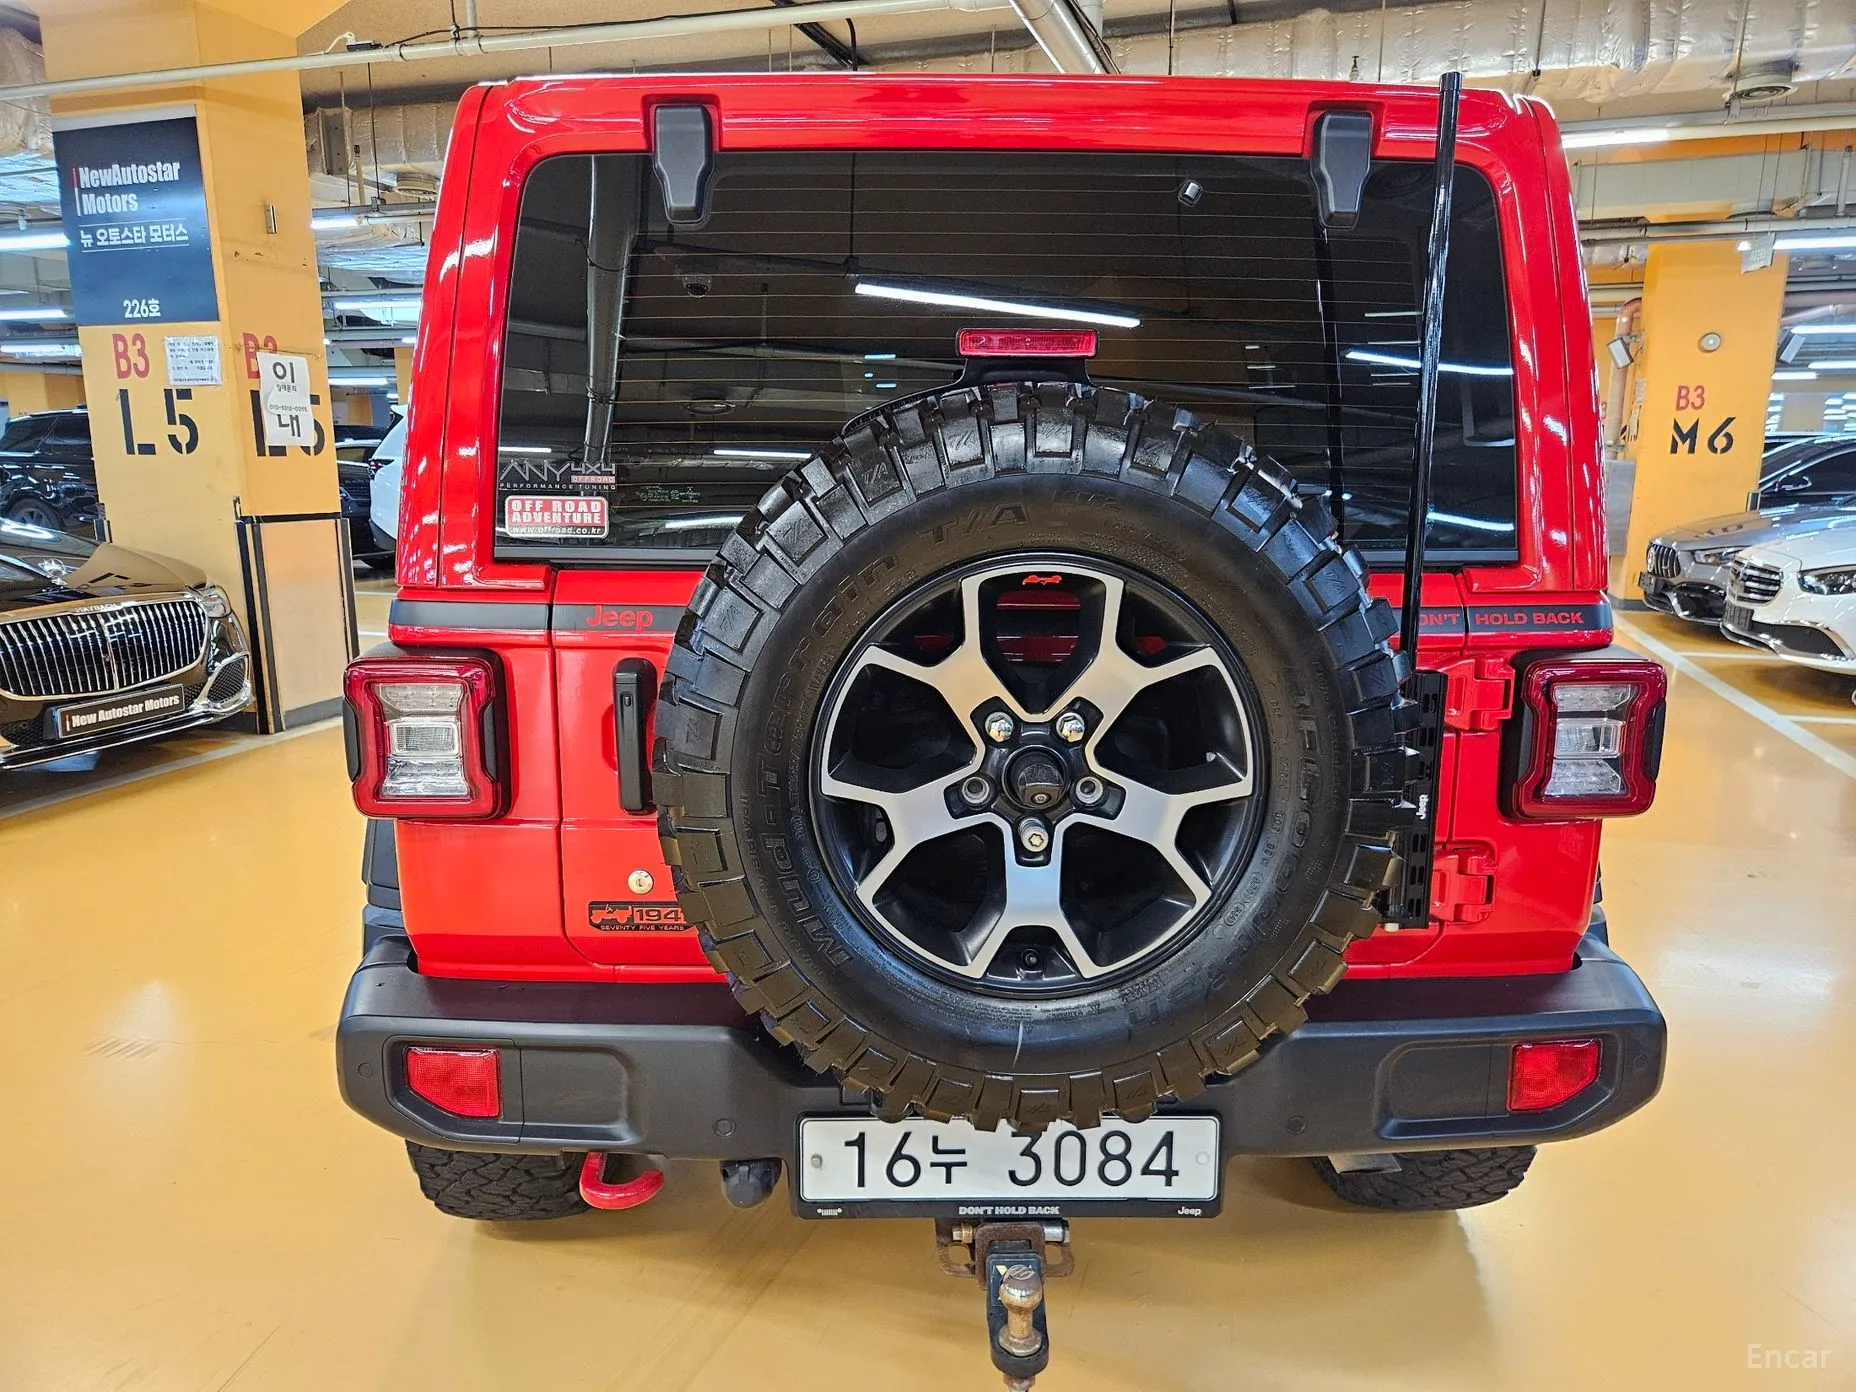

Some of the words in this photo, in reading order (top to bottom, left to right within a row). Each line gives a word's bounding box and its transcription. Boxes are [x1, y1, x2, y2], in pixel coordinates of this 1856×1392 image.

[78, 161, 181, 188] NewAutostar
[81, 193, 138, 215] Motors
[80, 230, 93, 248] 뉴
[96, 225, 147, 246] 오토스타
[149, 223, 189, 243] 모터스
[123, 298, 161, 318] 226호
[112, 333, 150, 379] B3
[272, 362, 295, 383] 이
[1675, 385, 1705, 412] B3
[499, 482, 574, 490] PERFORMANCE
[511, 500, 543, 513] OFF
[552, 500, 601, 513] ROAD
[511, 513, 601, 524] ADVENTURE
[586, 604, 653, 634] Jeep
[1475, 613, 1527, 625] HOLD
[1533, 612, 1584, 624] BACK
[71, 712, 97, 728] New
[98, 702, 144, 722] Autostar
[144, 694, 180, 711] Motors
[635, 908, 686, 922] 194
[600, 924, 636, 932] SEVENTY
[844, 1131, 968, 1188] 16누
[1008, 1130, 1179, 1187] 3084
[958, 1206, 993, 1215] DON'T
[995, 1206, 1027, 1215] HOLD
[1028, 1206, 1060, 1215] BACK
[1177, 1206, 1201, 1216] Jeep
